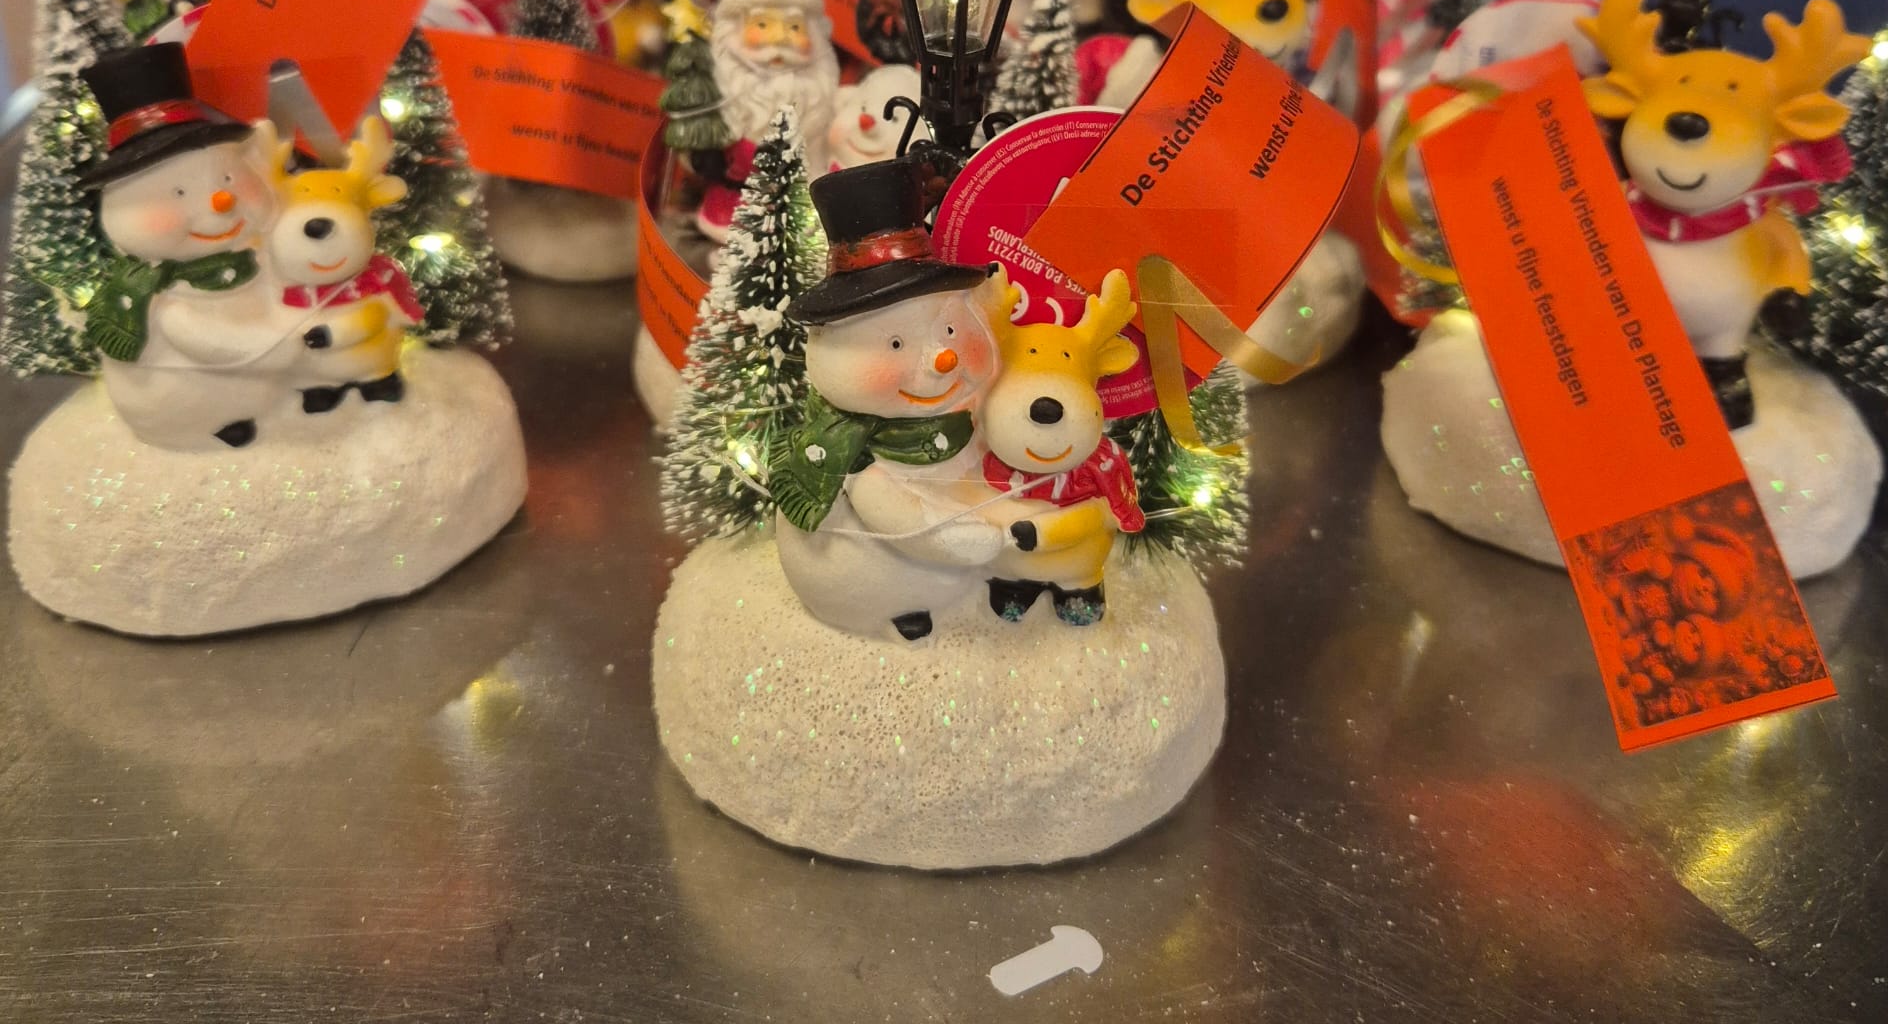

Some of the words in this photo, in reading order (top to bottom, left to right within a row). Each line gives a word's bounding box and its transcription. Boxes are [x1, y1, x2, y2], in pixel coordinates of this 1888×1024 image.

[1536, 98, 1553, 119] De
[1119, 173, 1156, 207] De
[1148, 85, 1223, 174] Stichting
[1249, 122, 1289, 180] wenst
[1279, 113, 1294, 128] u
[1543, 119, 1578, 192] Stichting
[1492, 175, 1522, 230] wenst
[986, 225, 1053, 267] ERLANDS
[987, 239, 1023, 265] 37211
[1511, 232, 1526, 247] u
[1570, 189, 1613, 277] Vrienden
[1018, 254, 1043, 276] BOX
[1045, 263, 1064, 285] P.O.
[1516, 246, 1543, 291] fijne
[1605, 279, 1631, 318] van
[1534, 293, 1589, 407] feestdagen
[1621, 319, 1645, 352] De
[1635, 352, 1686, 448] Plantage
